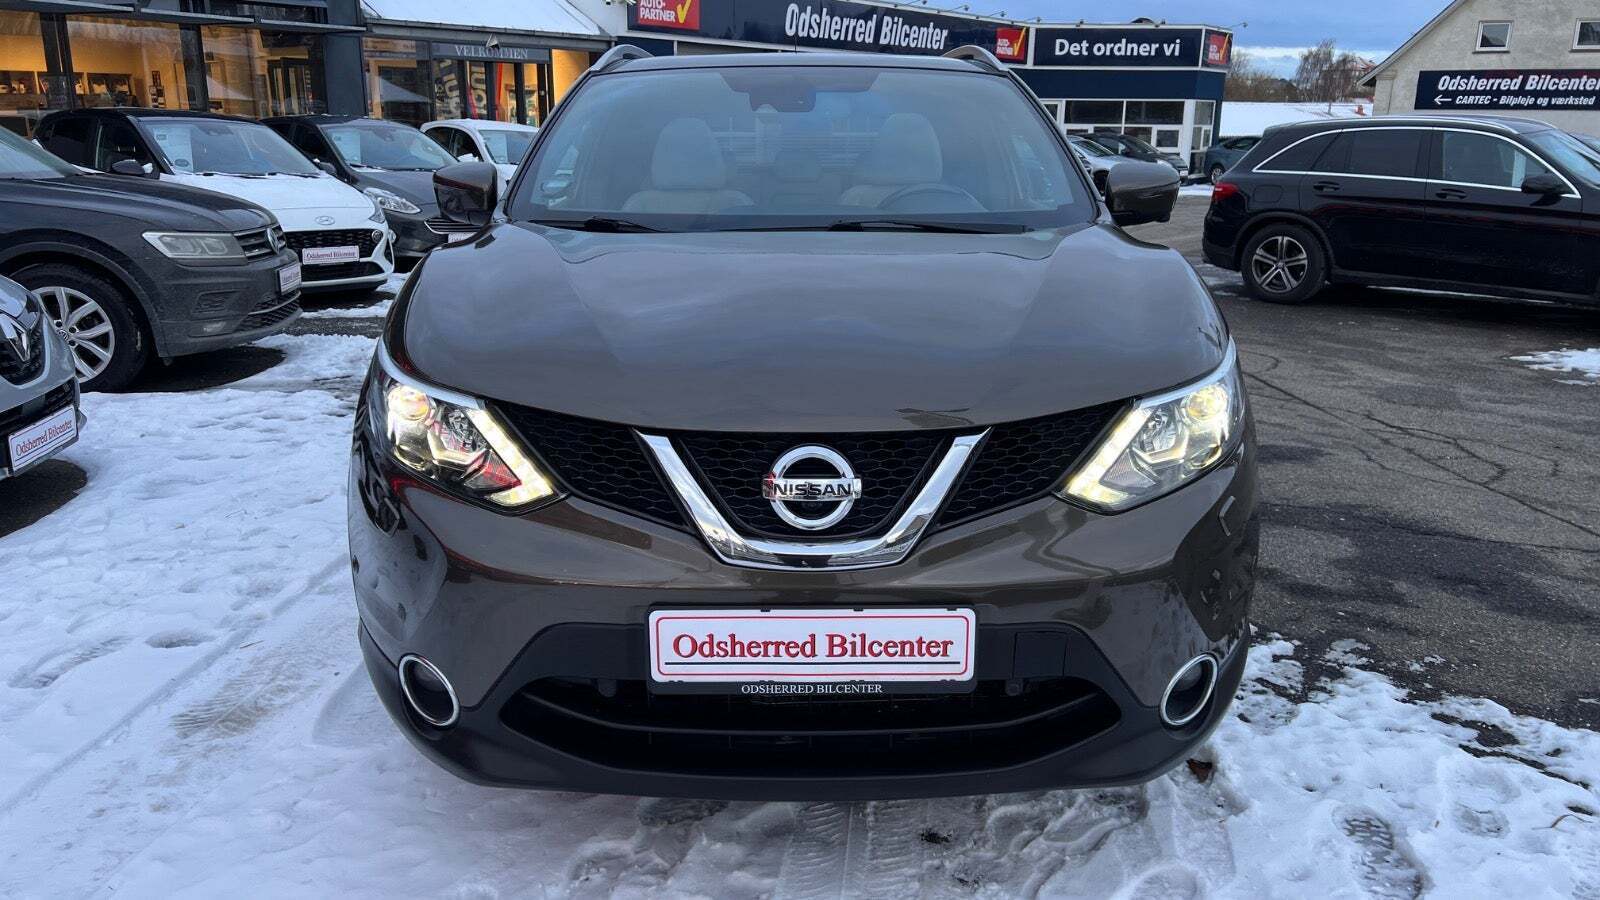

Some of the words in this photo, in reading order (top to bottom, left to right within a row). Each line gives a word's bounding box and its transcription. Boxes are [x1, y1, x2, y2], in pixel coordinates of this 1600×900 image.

[640, 7, 676, 23] PARTNER
[785, 3, 877, 44] Odsherred
[879, 15, 949, 50] Bilcenter
[455, 45, 528, 59] VELKOMMEN
[1055, 38, 1089, 56] Det
[1093, 38, 1159, 56] ordner
[1163, 38, 1181, 57] vi
[1438, 74, 1523, 91] Odsherred
[1456, 95, 1492, 105] CARTEC
[1499, 95, 1535, 107] Bilpleje
[1537, 96, 1549, 107] og
[1551, 95, 1596, 105] værksted
[16, 430, 48, 456] Odsherred
[774, 483, 852, 496] NISSAN
[672, 633, 818, 659] Odsherred
[825, 633, 954, 659] Bilcenter
[741, 684, 814, 694] ODSHERRED
[816, 684, 883, 694] BILCENTER
